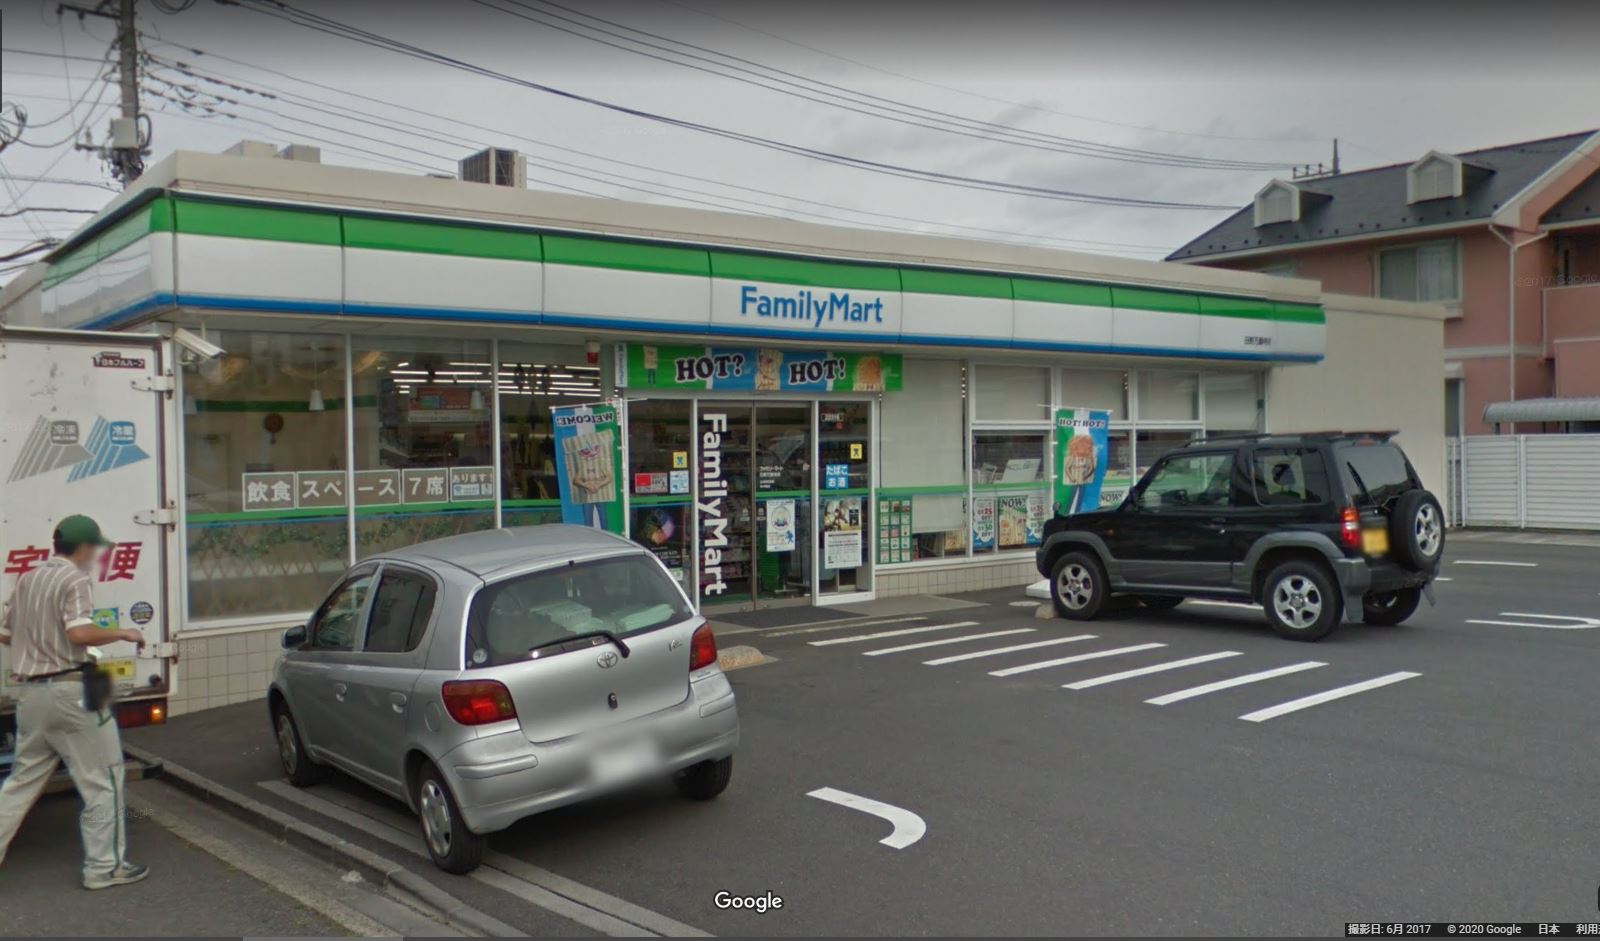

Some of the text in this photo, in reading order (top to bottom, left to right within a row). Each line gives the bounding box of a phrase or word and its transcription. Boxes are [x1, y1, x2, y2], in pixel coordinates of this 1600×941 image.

[741, 286, 883, 328] FamilyMart
[675, 354, 846, 384] HOT? HOT!
[248, 480, 292, 502] 飲食
[698, 413, 728, 596] FamilyMart
[4, 541, 142, 582] 宅便
